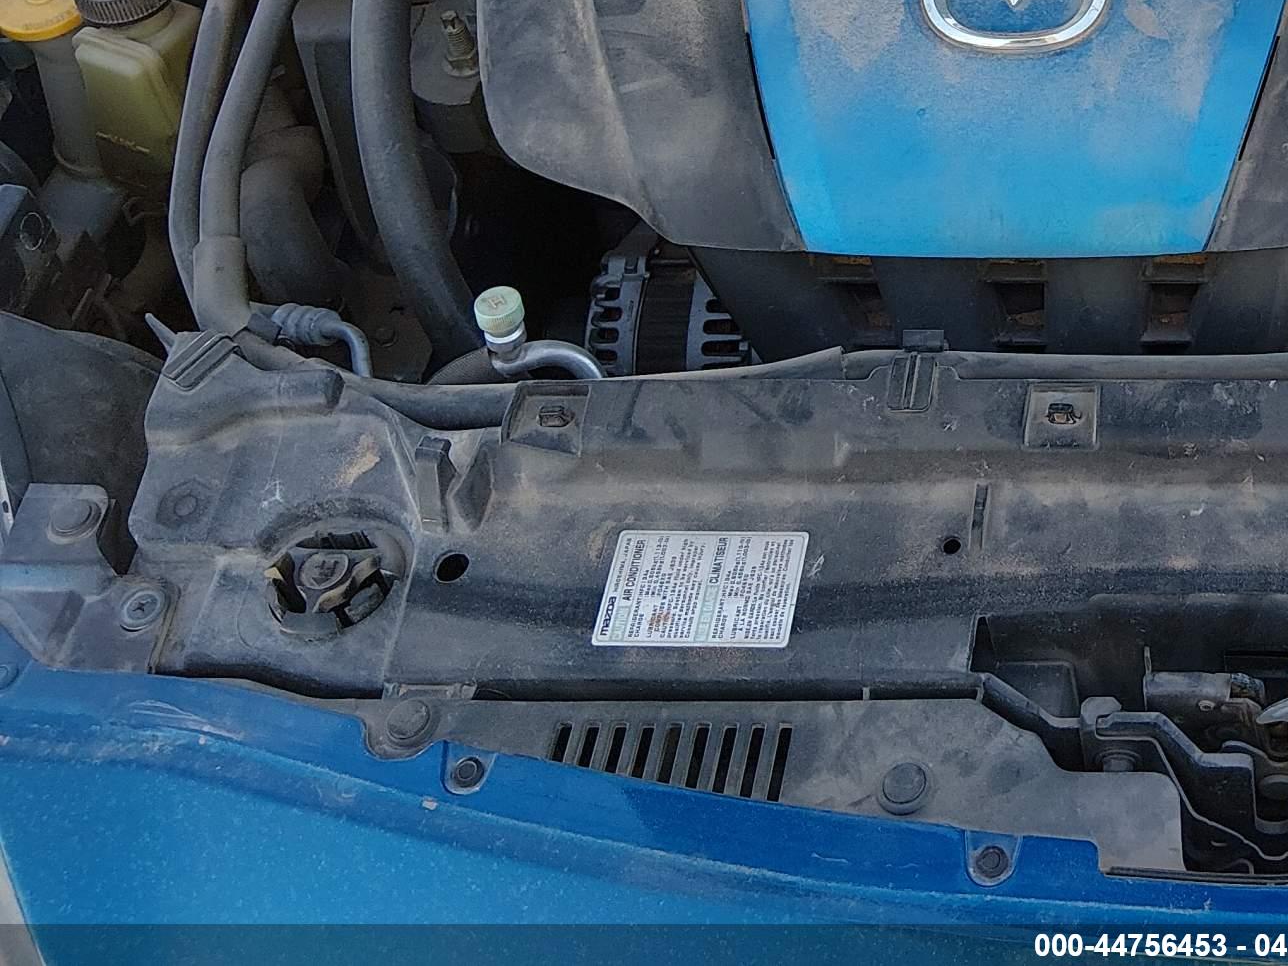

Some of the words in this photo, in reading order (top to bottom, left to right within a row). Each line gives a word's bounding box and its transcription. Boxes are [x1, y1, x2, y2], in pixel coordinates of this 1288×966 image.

[625, 539, 646, 586] CONDITIONER
[709, 537, 728, 583] CLIMATISEUR
[600, 596, 616, 635] mazda
[622, 588, 633, 601] AIR
